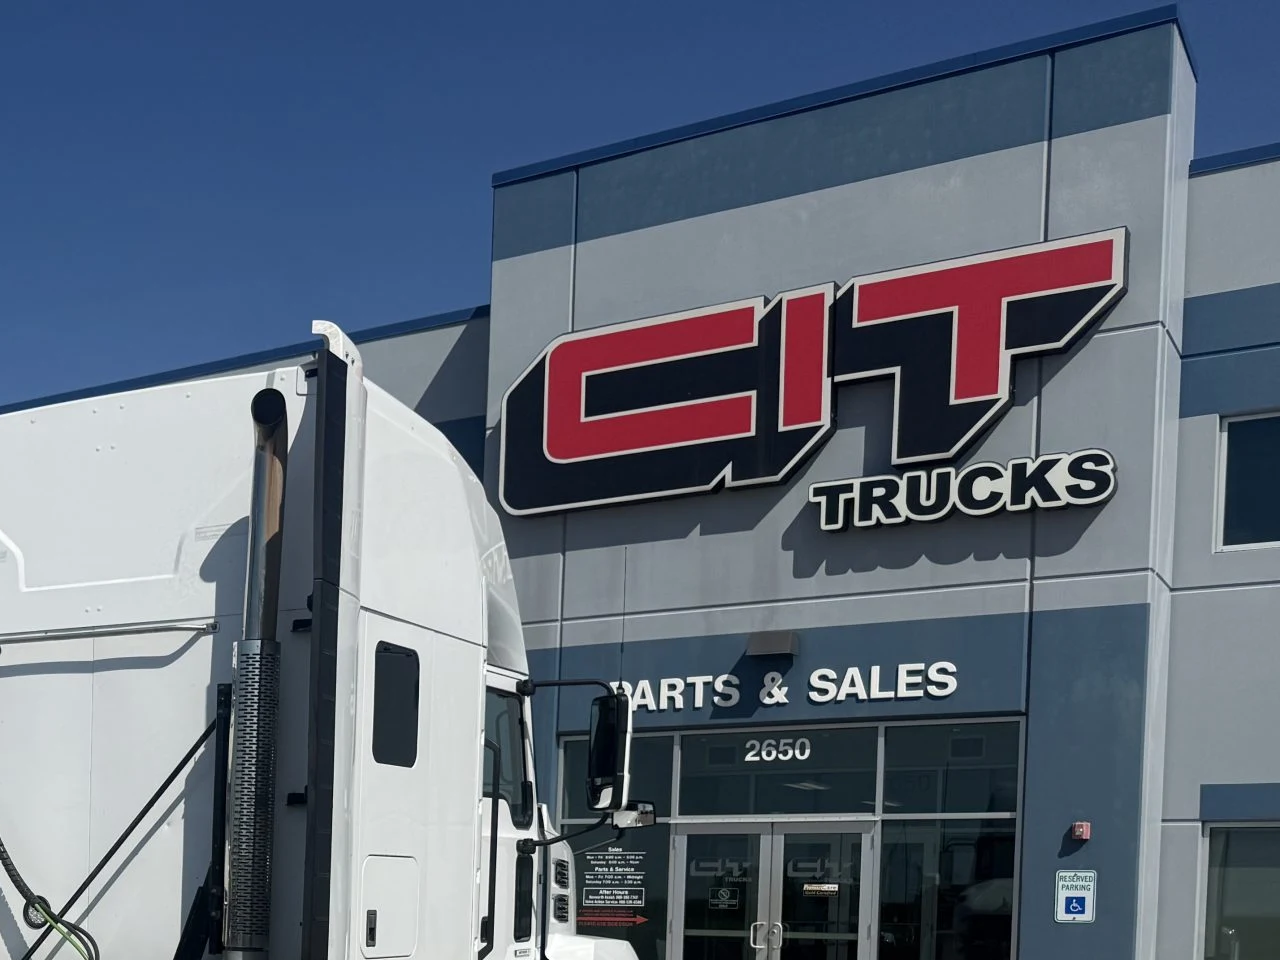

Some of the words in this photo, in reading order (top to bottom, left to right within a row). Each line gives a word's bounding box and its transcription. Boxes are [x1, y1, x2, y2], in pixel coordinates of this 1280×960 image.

[501, 227, 1127, 515] CIT
[810, 449, 1116, 531] TRUCKS
[759, 671, 789, 704] &
[808, 661, 958, 702] SALES
[744, 738, 811, 762] 2650
[1060, 875, 1093, 883] RESERVED
